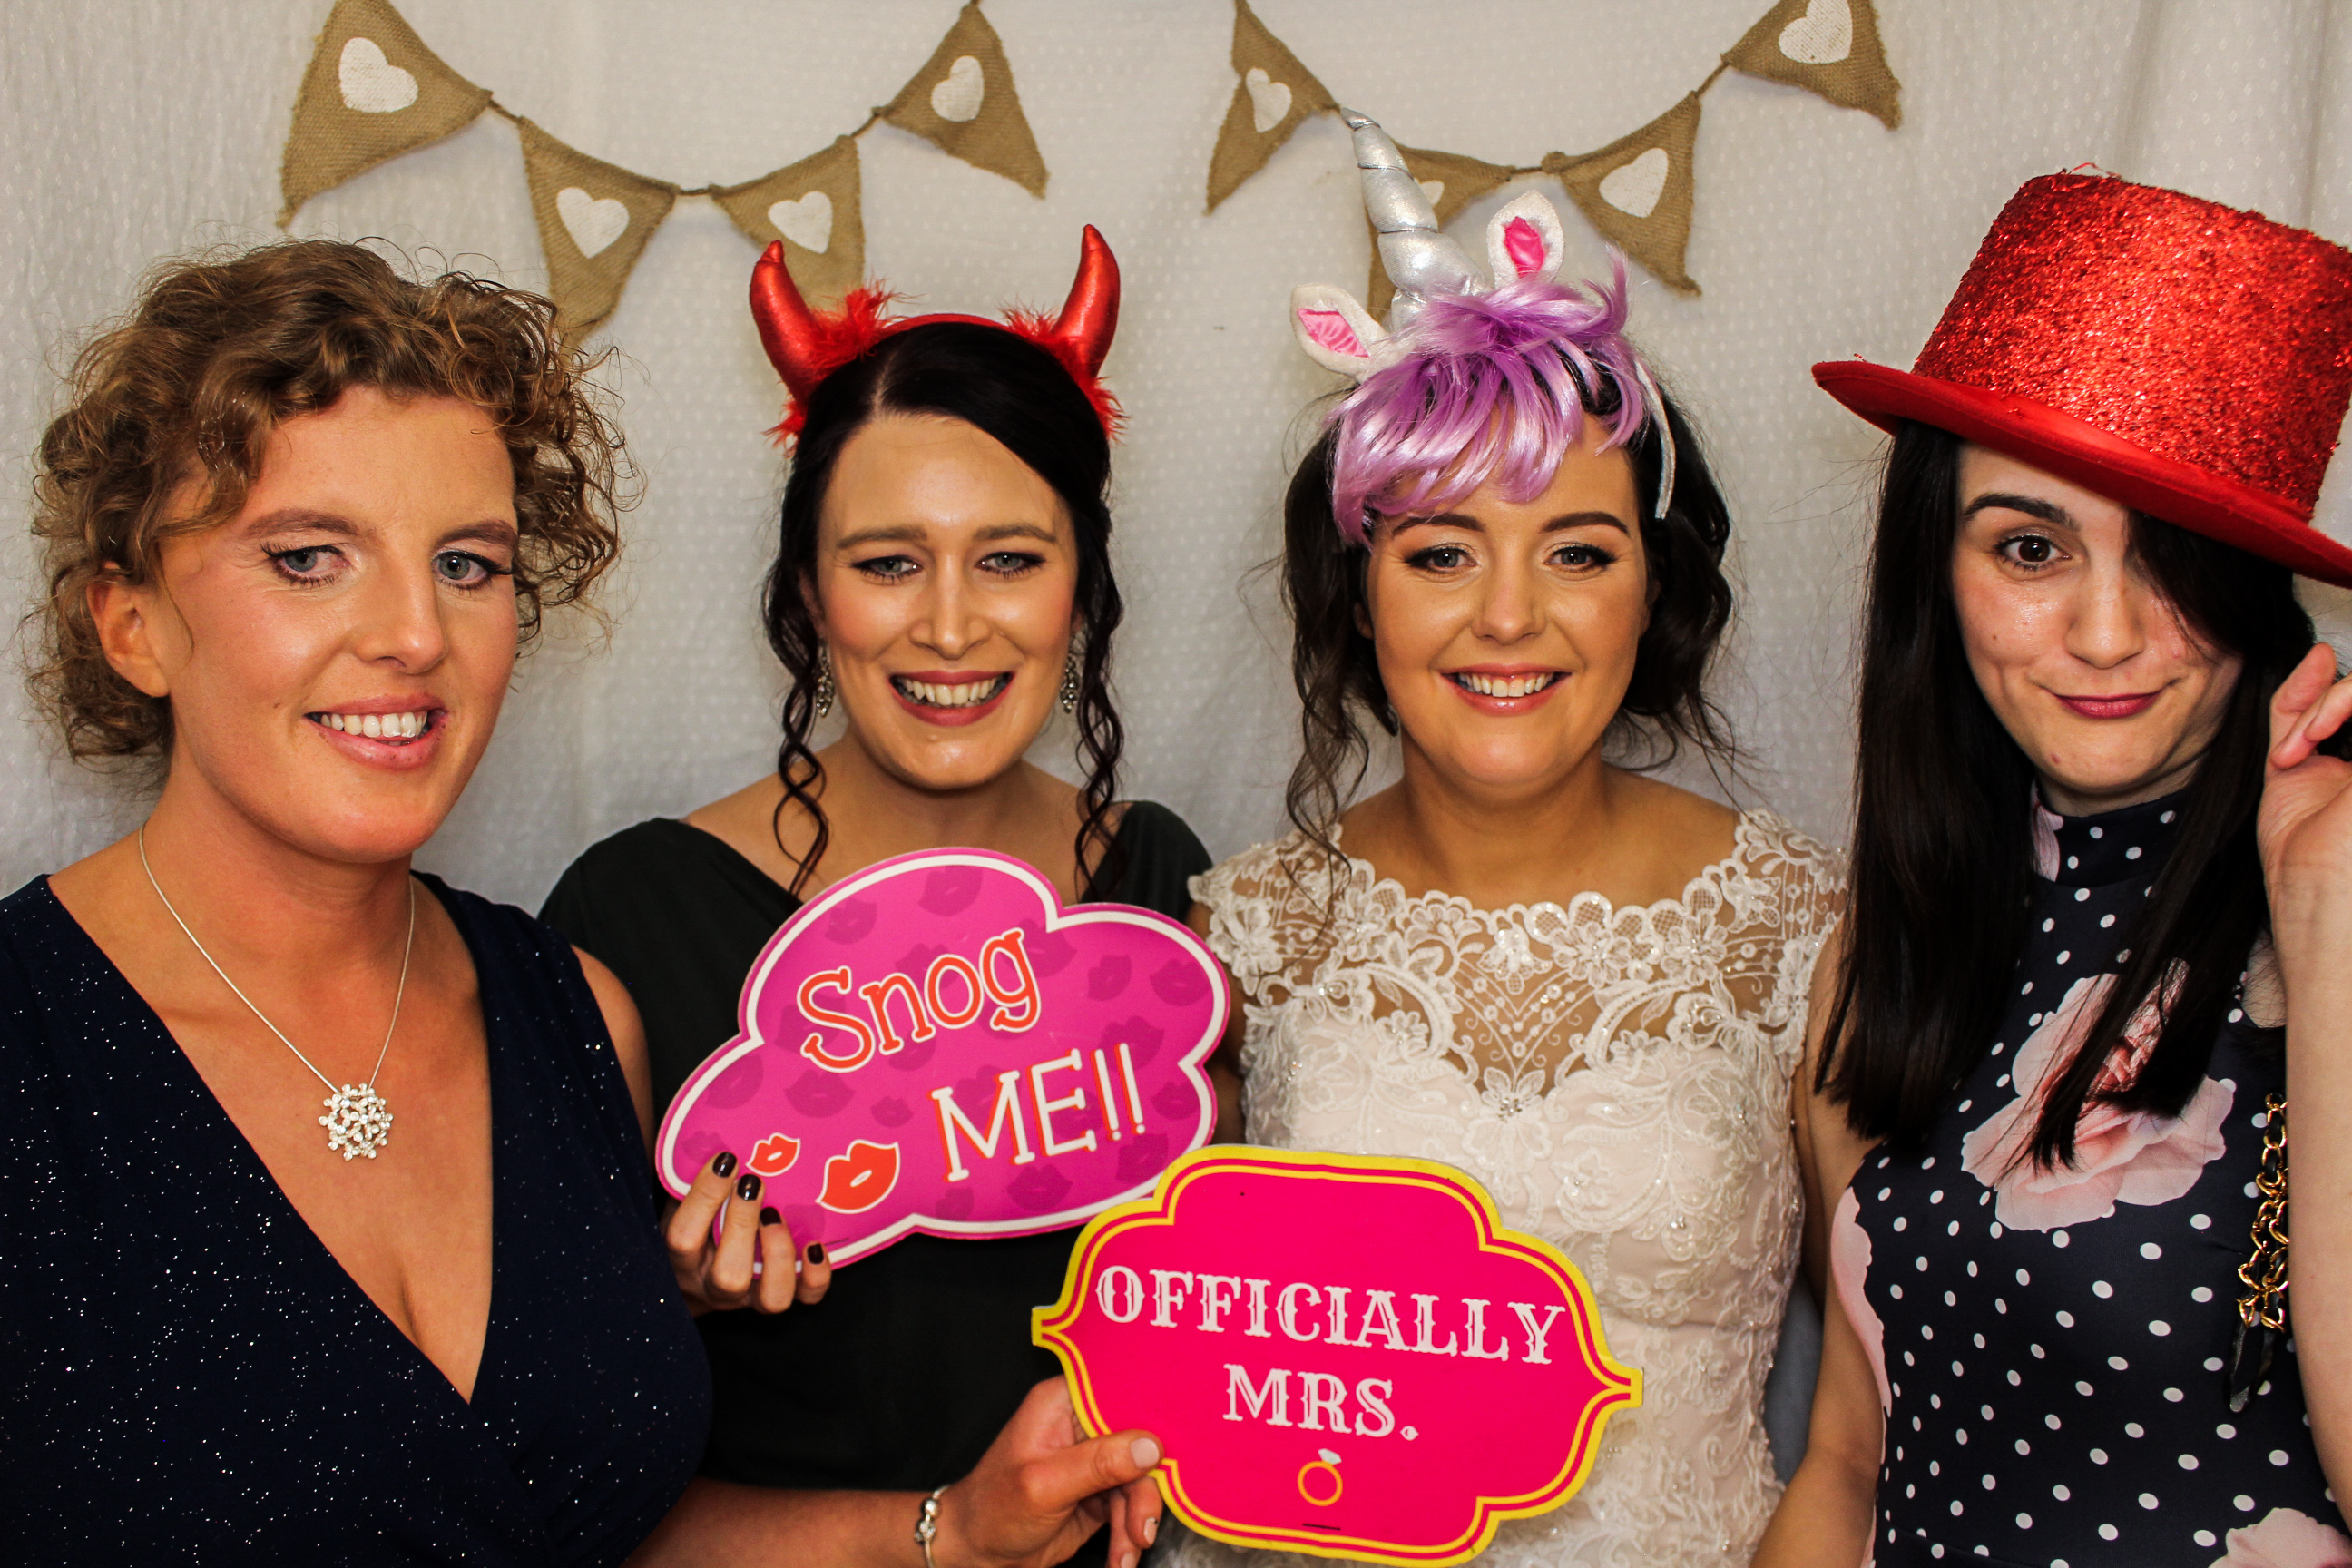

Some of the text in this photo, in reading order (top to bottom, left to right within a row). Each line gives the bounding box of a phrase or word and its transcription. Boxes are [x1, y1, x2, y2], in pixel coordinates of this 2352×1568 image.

[797, 928, 1042, 1073] Snog
[927, 1043, 1146, 1183] ME!!
[1095, 1265, 1566, 1365] OFFICIALLY
[1222, 1364, 1420, 1442] MRS.
